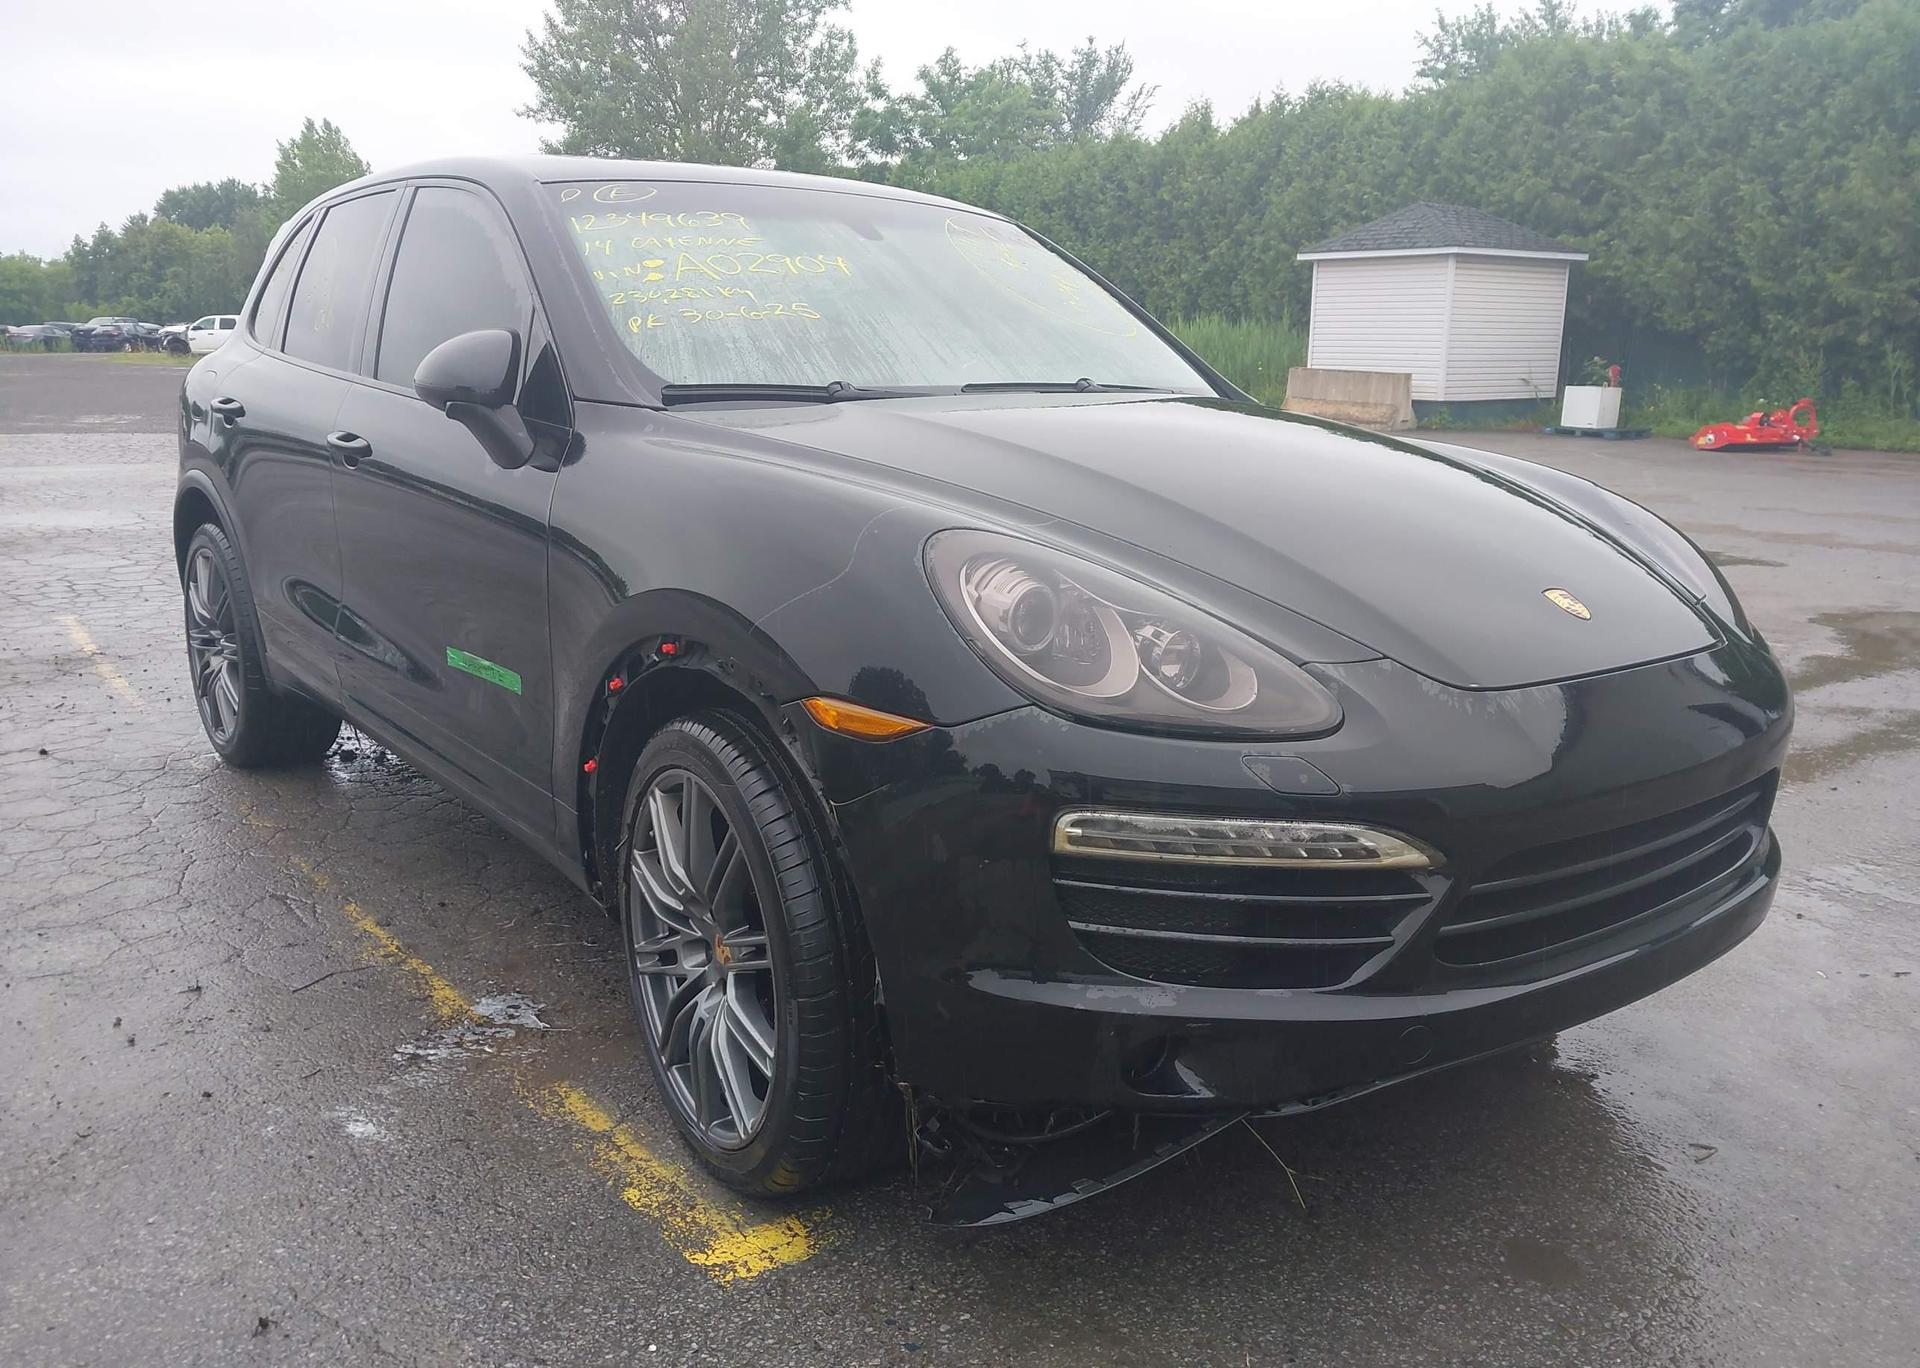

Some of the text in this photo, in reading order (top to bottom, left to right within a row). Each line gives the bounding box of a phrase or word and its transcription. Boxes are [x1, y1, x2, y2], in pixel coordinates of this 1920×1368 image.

[569, 211, 751, 234] 12349639
[583, 239, 612, 256] 14
[675, 252, 852, 281] A02904
